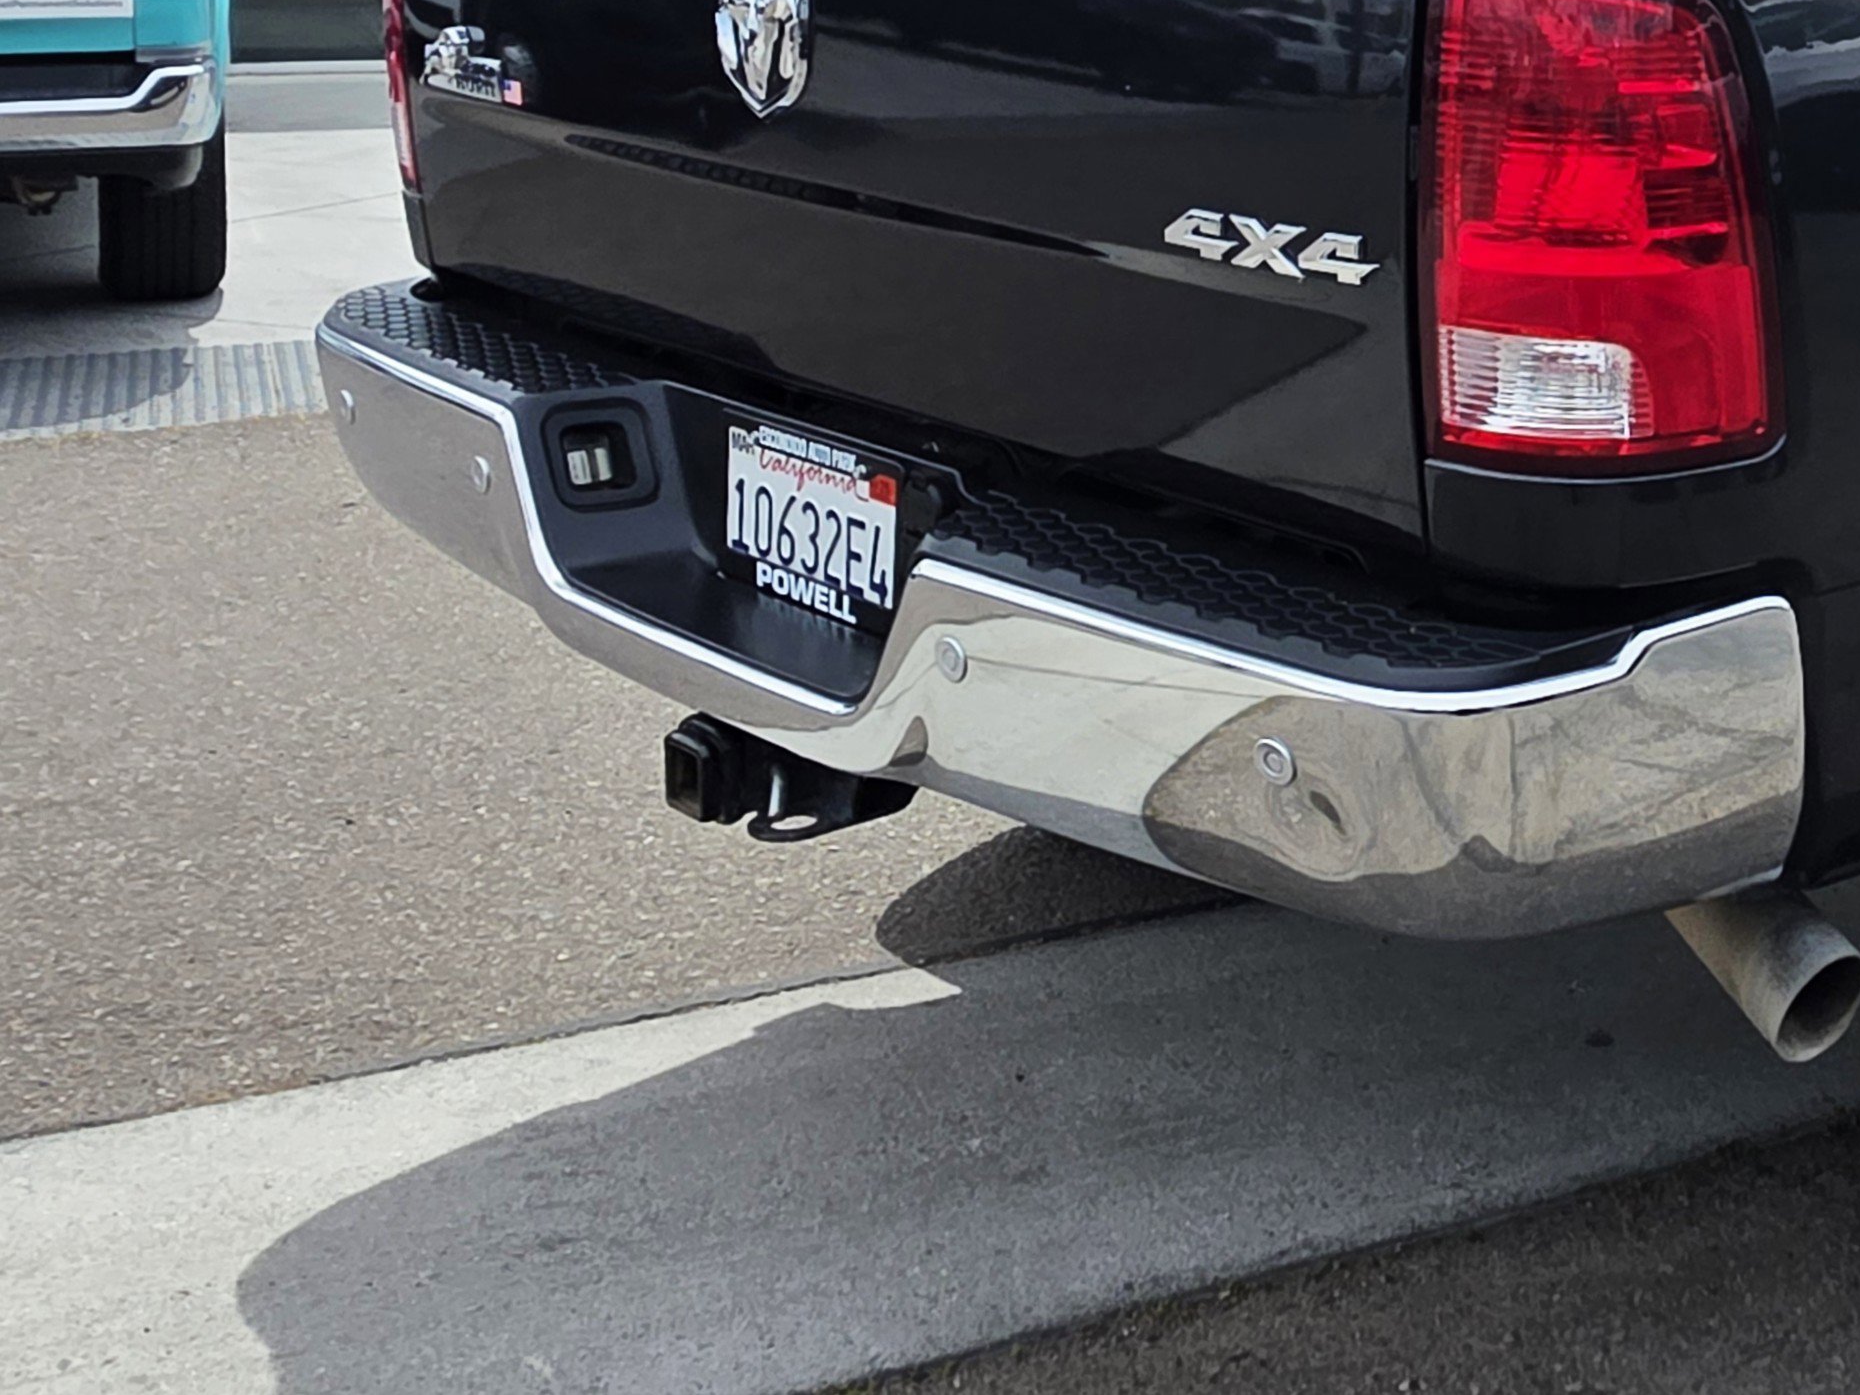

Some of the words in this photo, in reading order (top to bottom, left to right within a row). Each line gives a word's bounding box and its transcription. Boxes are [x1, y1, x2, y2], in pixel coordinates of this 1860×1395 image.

[1164, 208, 1380, 285] 4X4
[732, 477, 887, 606] 10632E4
[756, 561, 857, 624] POWELL
